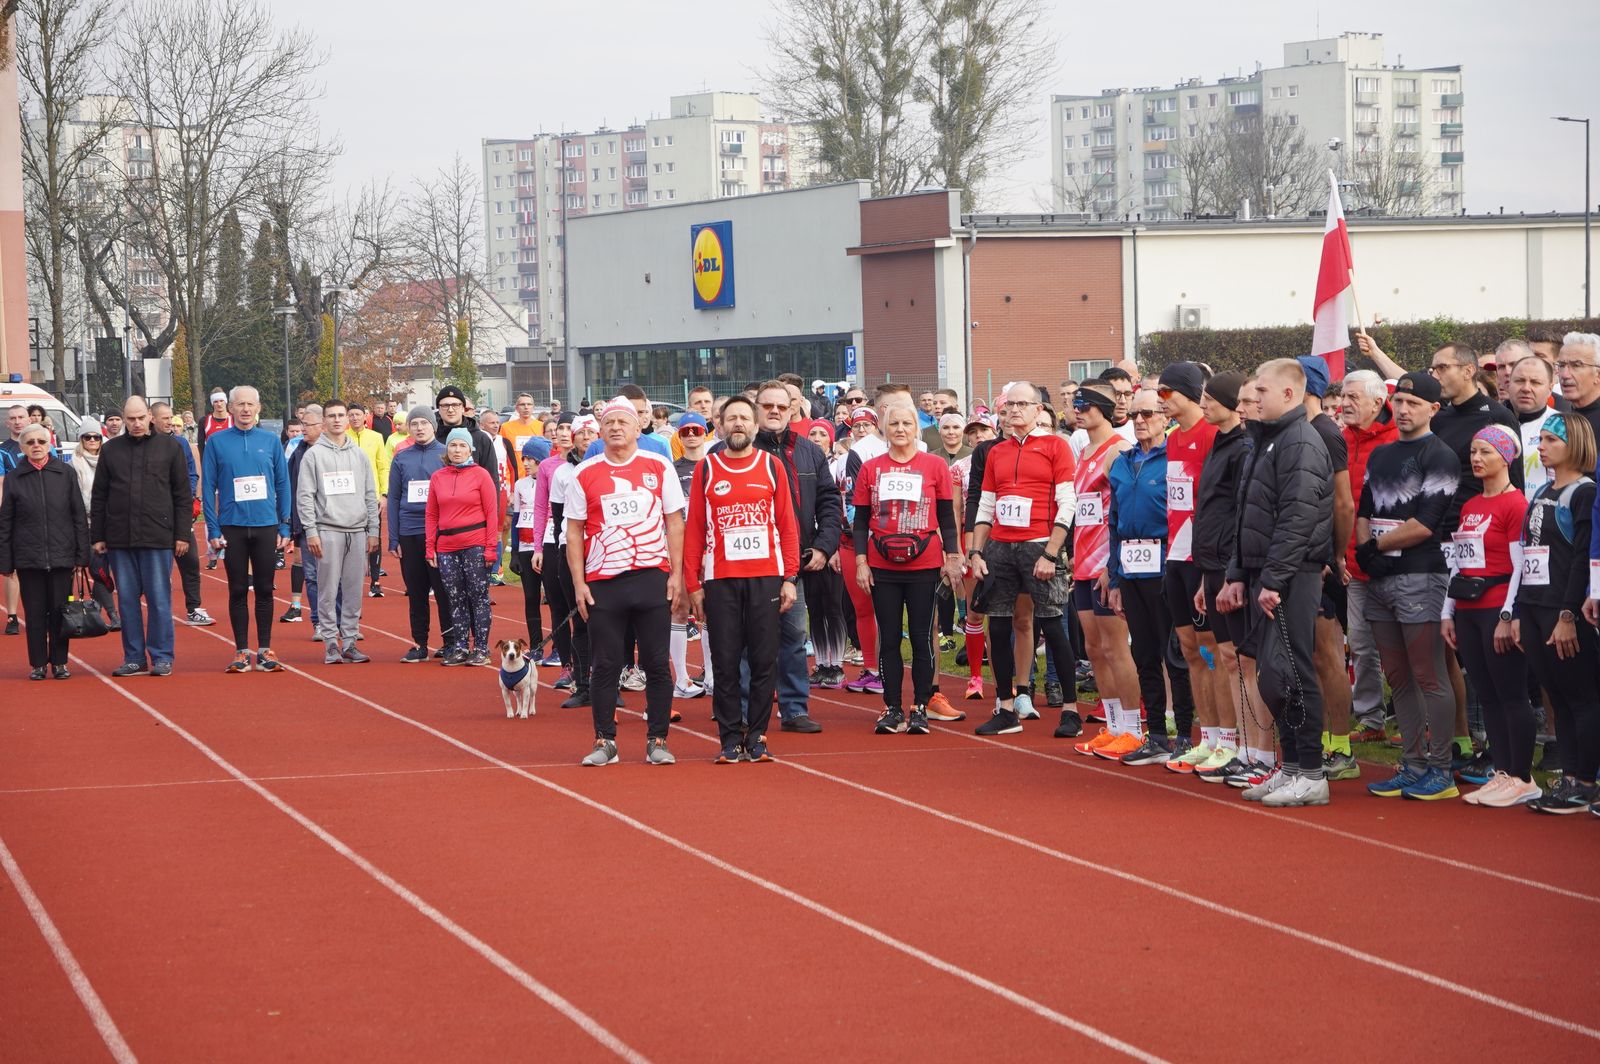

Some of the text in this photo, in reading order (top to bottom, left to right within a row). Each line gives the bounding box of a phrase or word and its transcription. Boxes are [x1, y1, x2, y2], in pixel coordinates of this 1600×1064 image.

[243, 483, 258, 494] 95
[331, 478, 350, 488] 159
[887, 480, 913, 492] 559
[610, 500, 638, 516] 339
[716, 502, 762, 516] DRUŻYNA
[1000, 503, 1021, 517] 311
[717, 511, 769, 530] SZPIKU
[733, 537, 760, 550] 405
[1458, 543, 1475, 558] 236
[1126, 548, 1152, 563] 329
